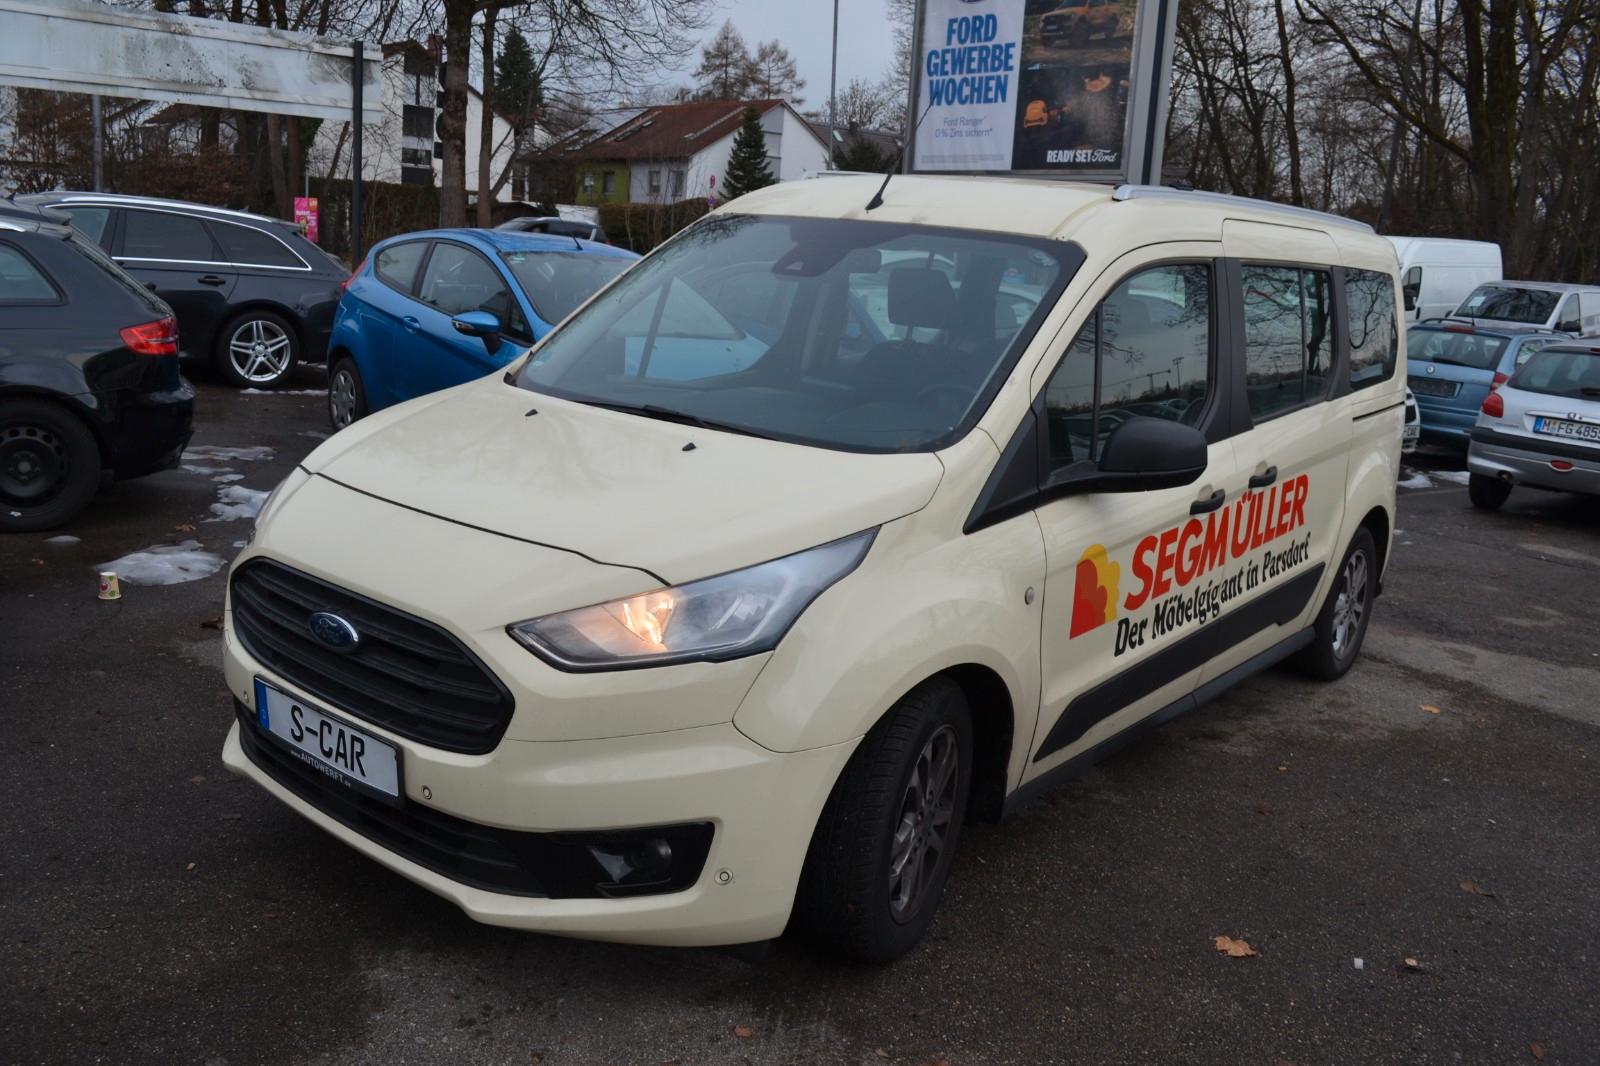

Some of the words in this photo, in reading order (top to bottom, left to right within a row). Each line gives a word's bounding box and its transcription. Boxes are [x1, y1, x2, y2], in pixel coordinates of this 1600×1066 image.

[946, 13, 998, 46] FORD
[926, 42, 1016, 77] GEWERBE
[929, 74, 1009, 106] WOCHEN
[943, 117, 959, 127] Ford
[1046, 149, 1075, 163] READY
[1075, 149, 1093, 163] SET
[1092, 148, 1119, 162] Ford
[1123, 474, 1309, 611] SEGMÜLLER
[1114, 615, 1148, 658] Der
[1151, 570, 1244, 641] Möbelgigant
[1245, 558, 1259, 590] in
[1262, 531, 1311, 582] Parsdorf
[290, 704, 367, 777] S-CAR
